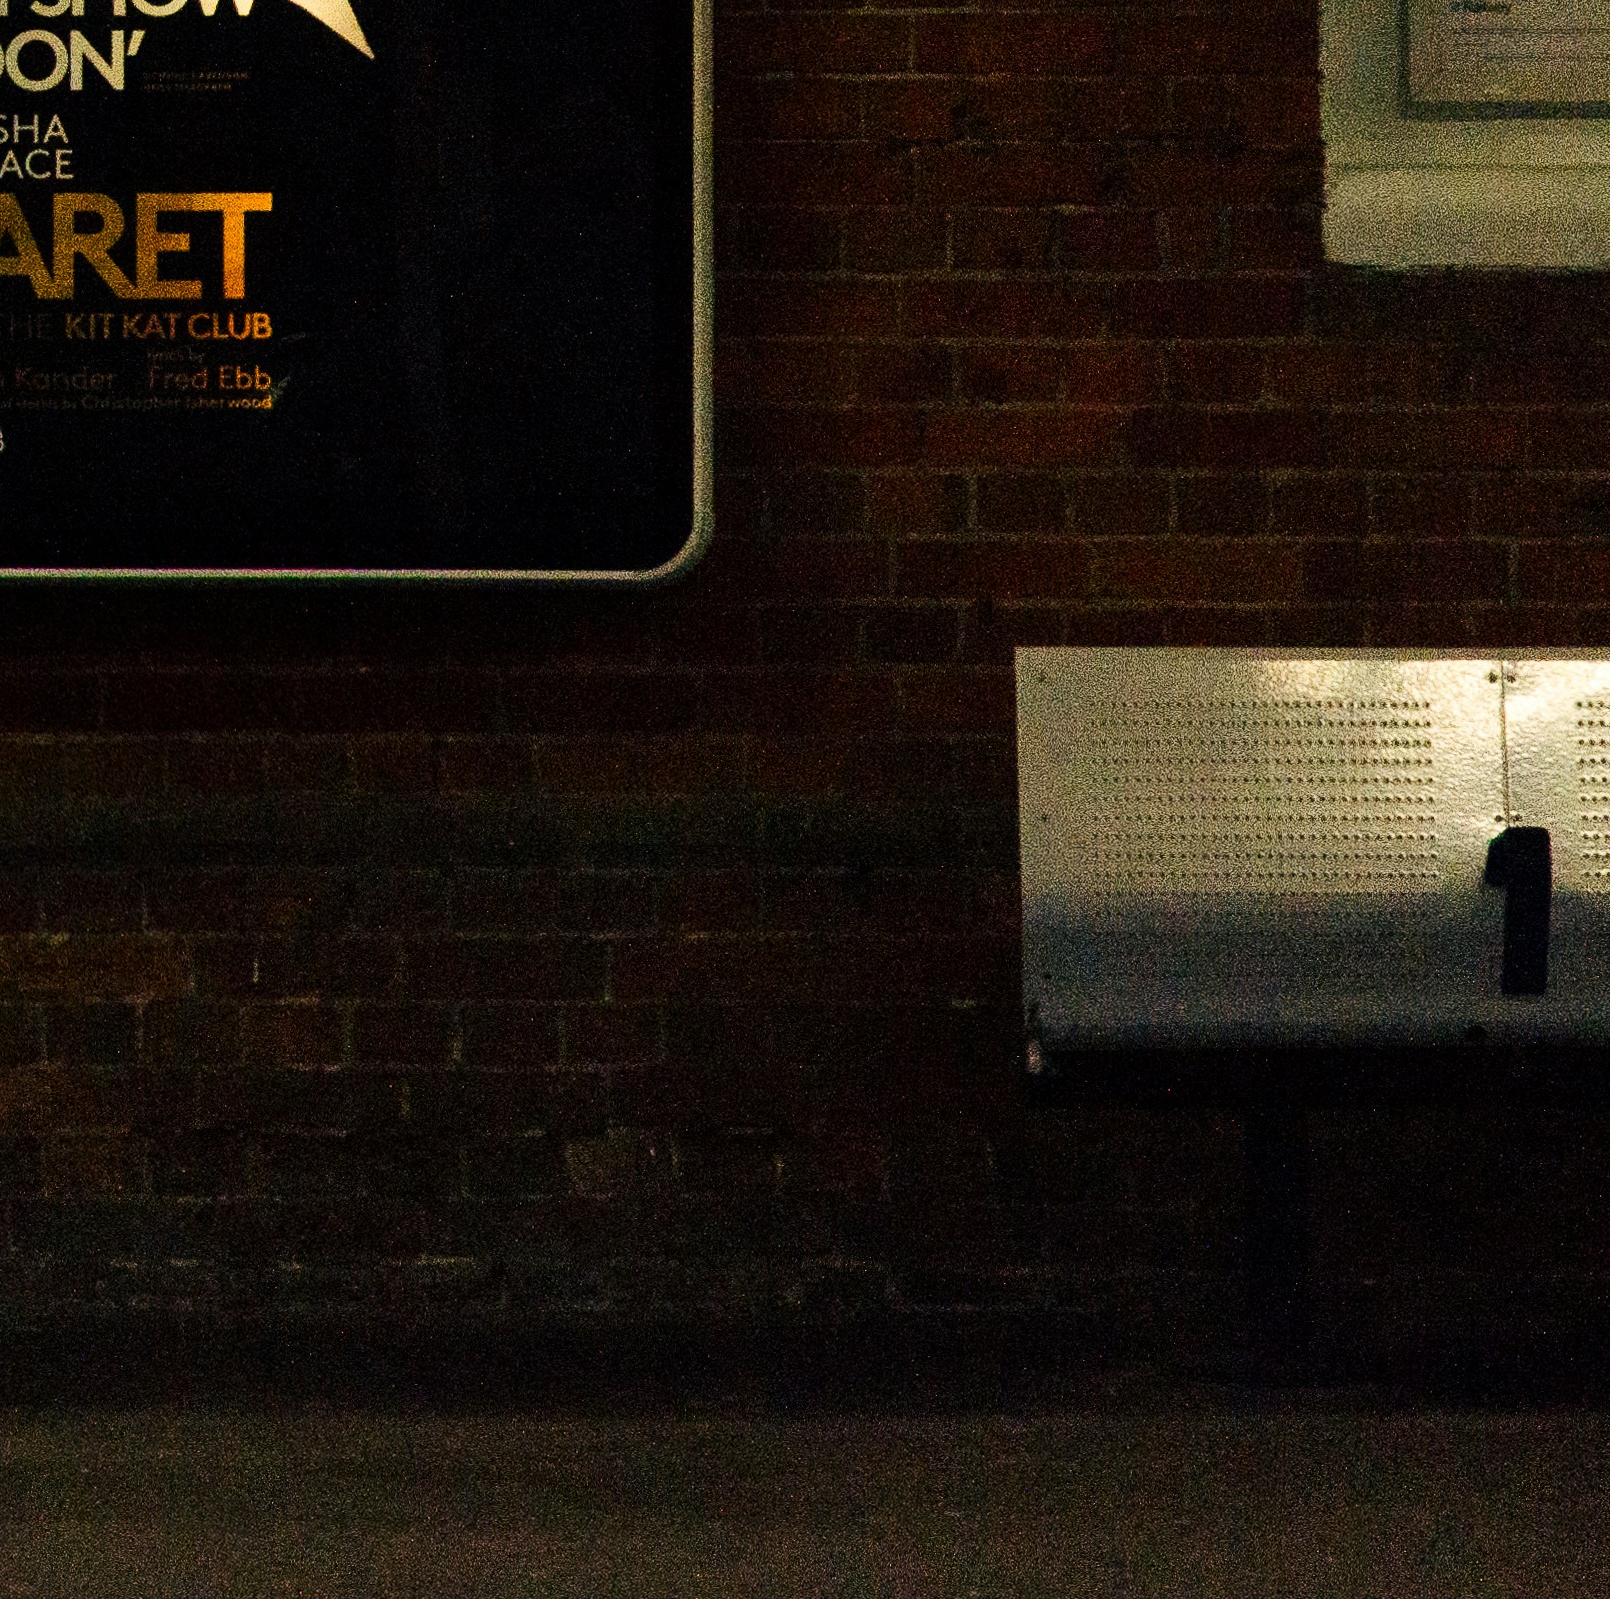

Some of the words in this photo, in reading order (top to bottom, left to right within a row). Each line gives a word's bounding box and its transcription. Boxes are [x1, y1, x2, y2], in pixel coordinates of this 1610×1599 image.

[64, 312, 116, 340] KIT
[122, 312, 183, 340] KAT
[186, 312, 273, 340] CLUB
[15, 365, 116, 390] Kander
[148, 365, 208, 390] Fred
[219, 365, 272, 390] Ebb
